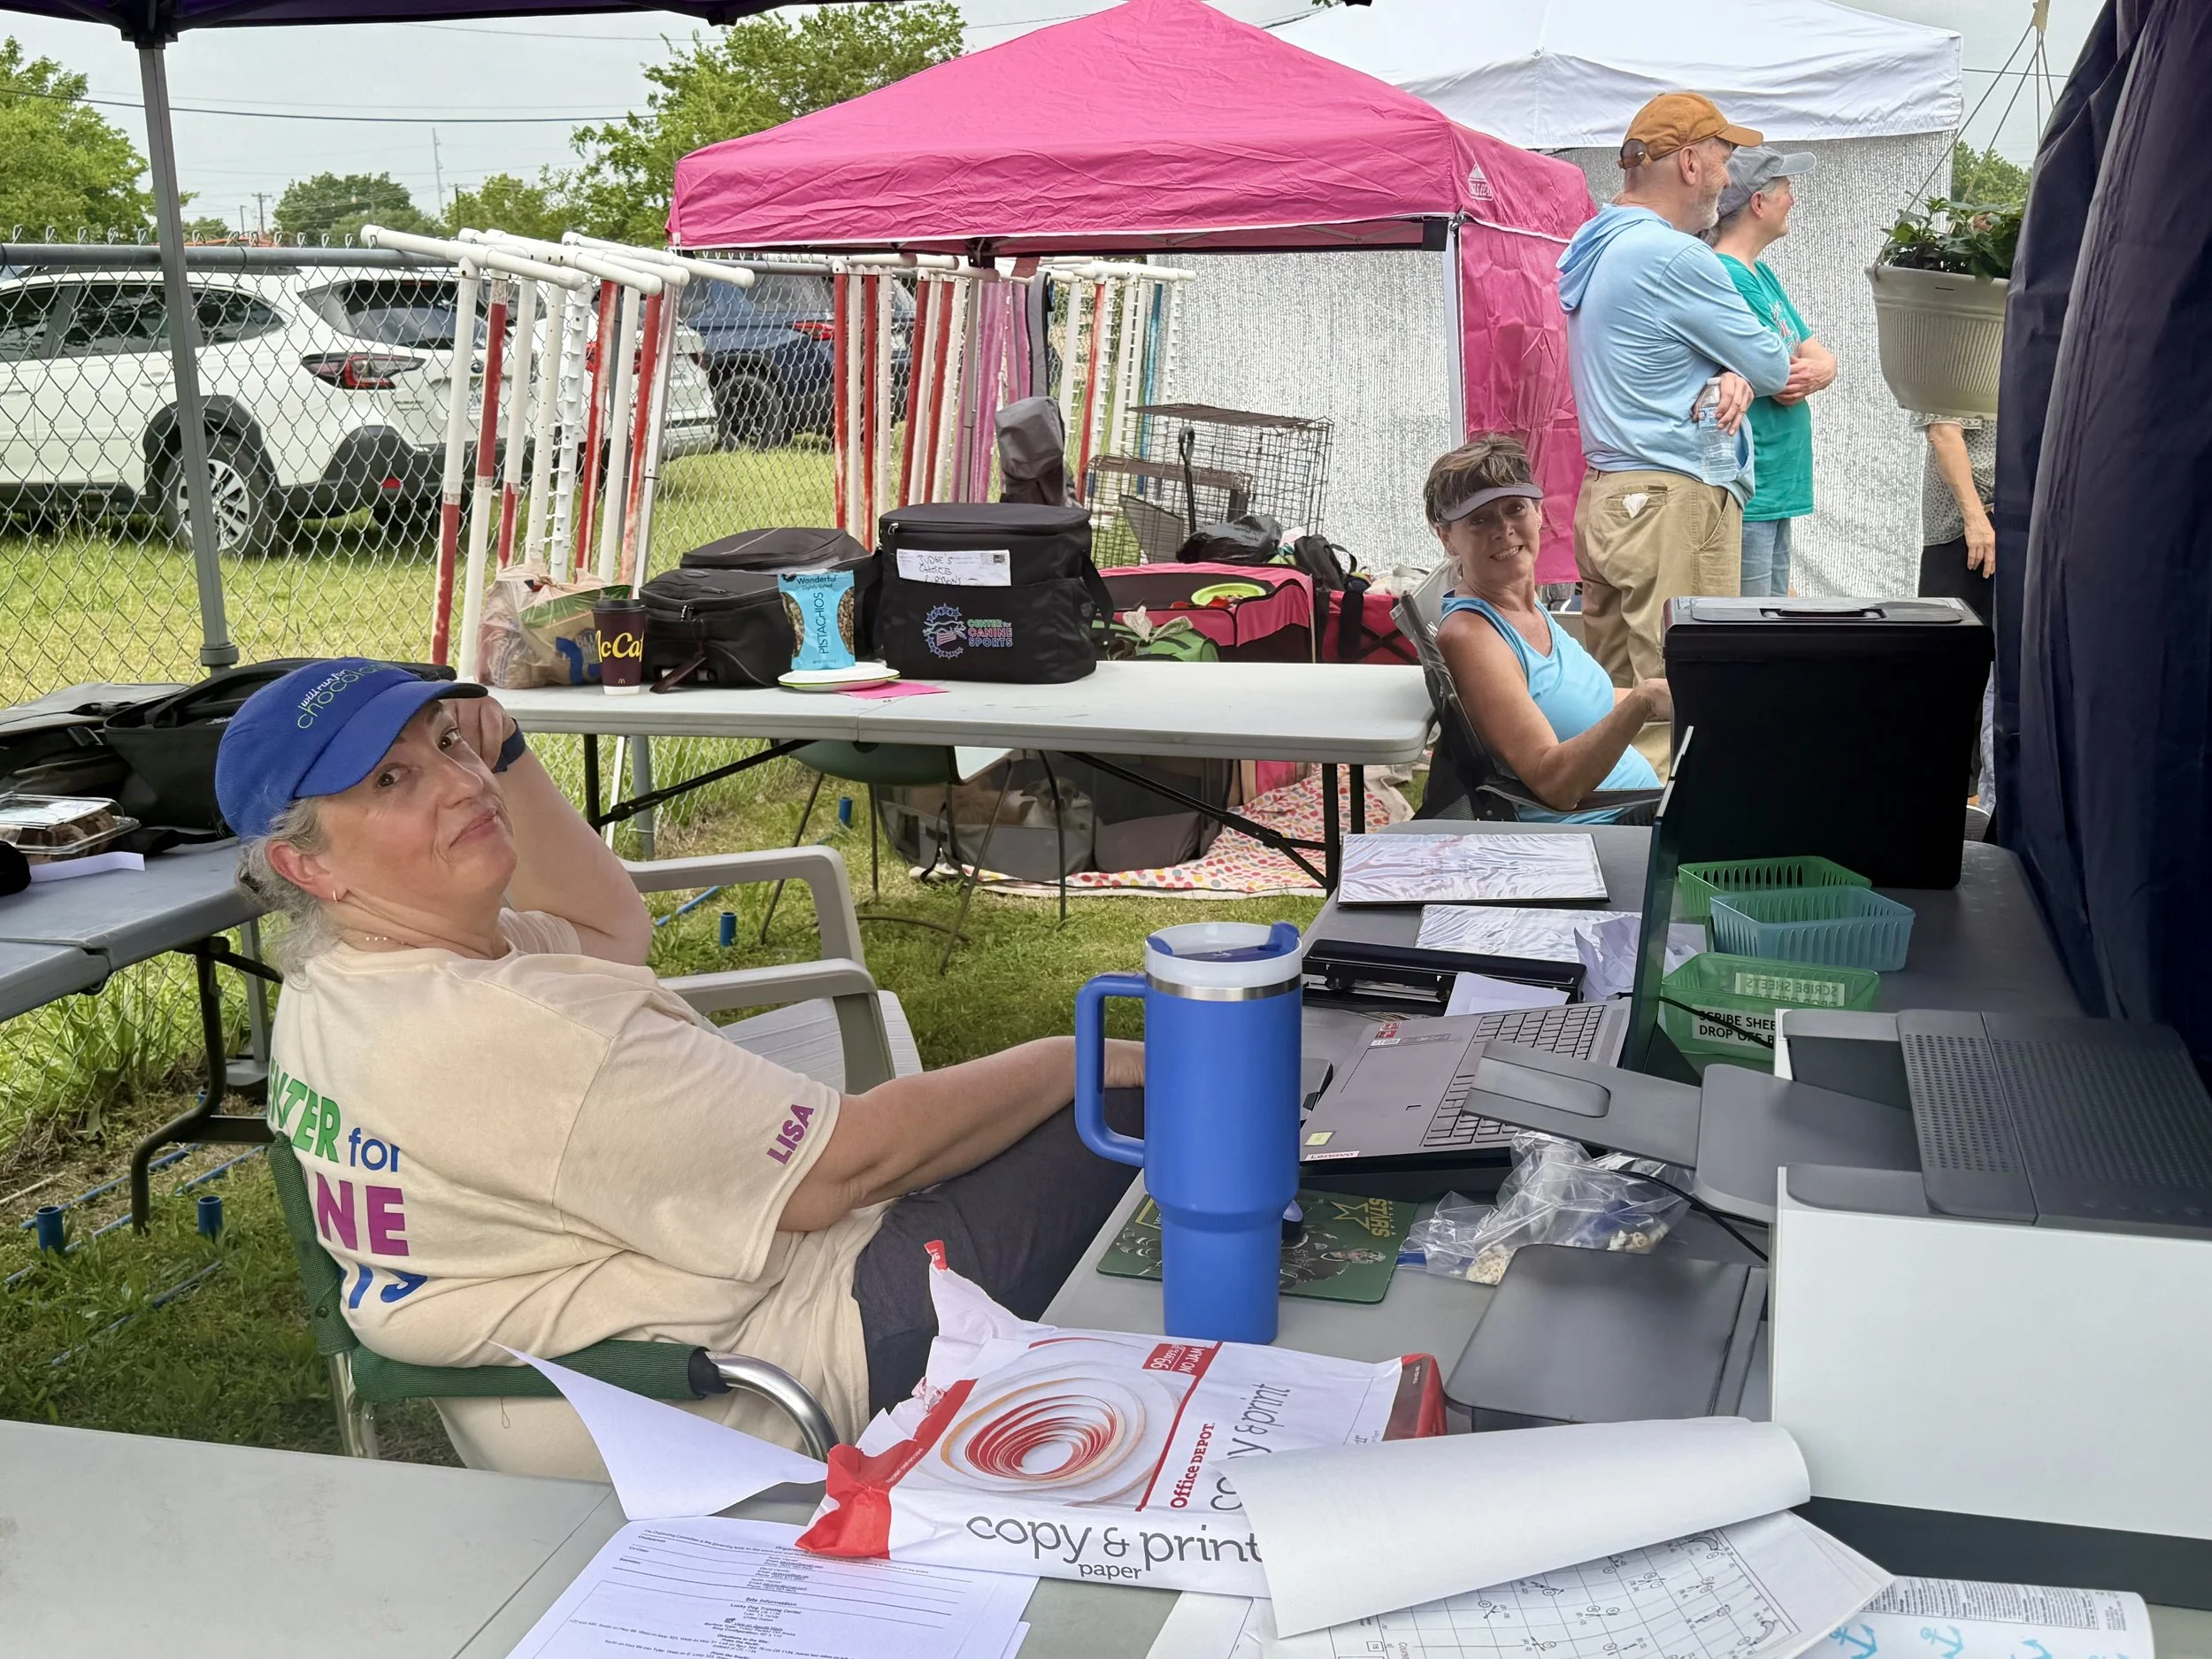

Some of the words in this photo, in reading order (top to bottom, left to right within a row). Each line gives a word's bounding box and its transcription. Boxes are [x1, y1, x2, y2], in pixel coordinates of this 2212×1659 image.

[796, 574, 837, 585] Wonderful
[813, 592, 829, 655] PISTACHIOS
[967, 618, 1002, 628] CENTER
[967, 628, 1013, 638] CANINE
[968, 637, 1013, 648] SPORTS
[1699, 1010, 1742, 1026] SCRIBE
[1699, 1025, 1733, 1041] DROP
[766, 1103, 815, 1165] LISA
[349, 1126, 401, 1172] for
[315, 1171, 410, 1257] NE
[1368, 1197, 1393, 1238] STARS
[1186, 1347, 1205, 1363] JAM
[1179, 1362, 1195, 1373] NO
[1240, 1383, 1291, 1427] print
[1170, 1463, 1201, 1509] Office
[965, 1515, 1093, 1564] copy
[1102, 1526, 1130, 1558] &
[1139, 1524, 1263, 1572] print
[1077, 1563, 1142, 1580] paper
